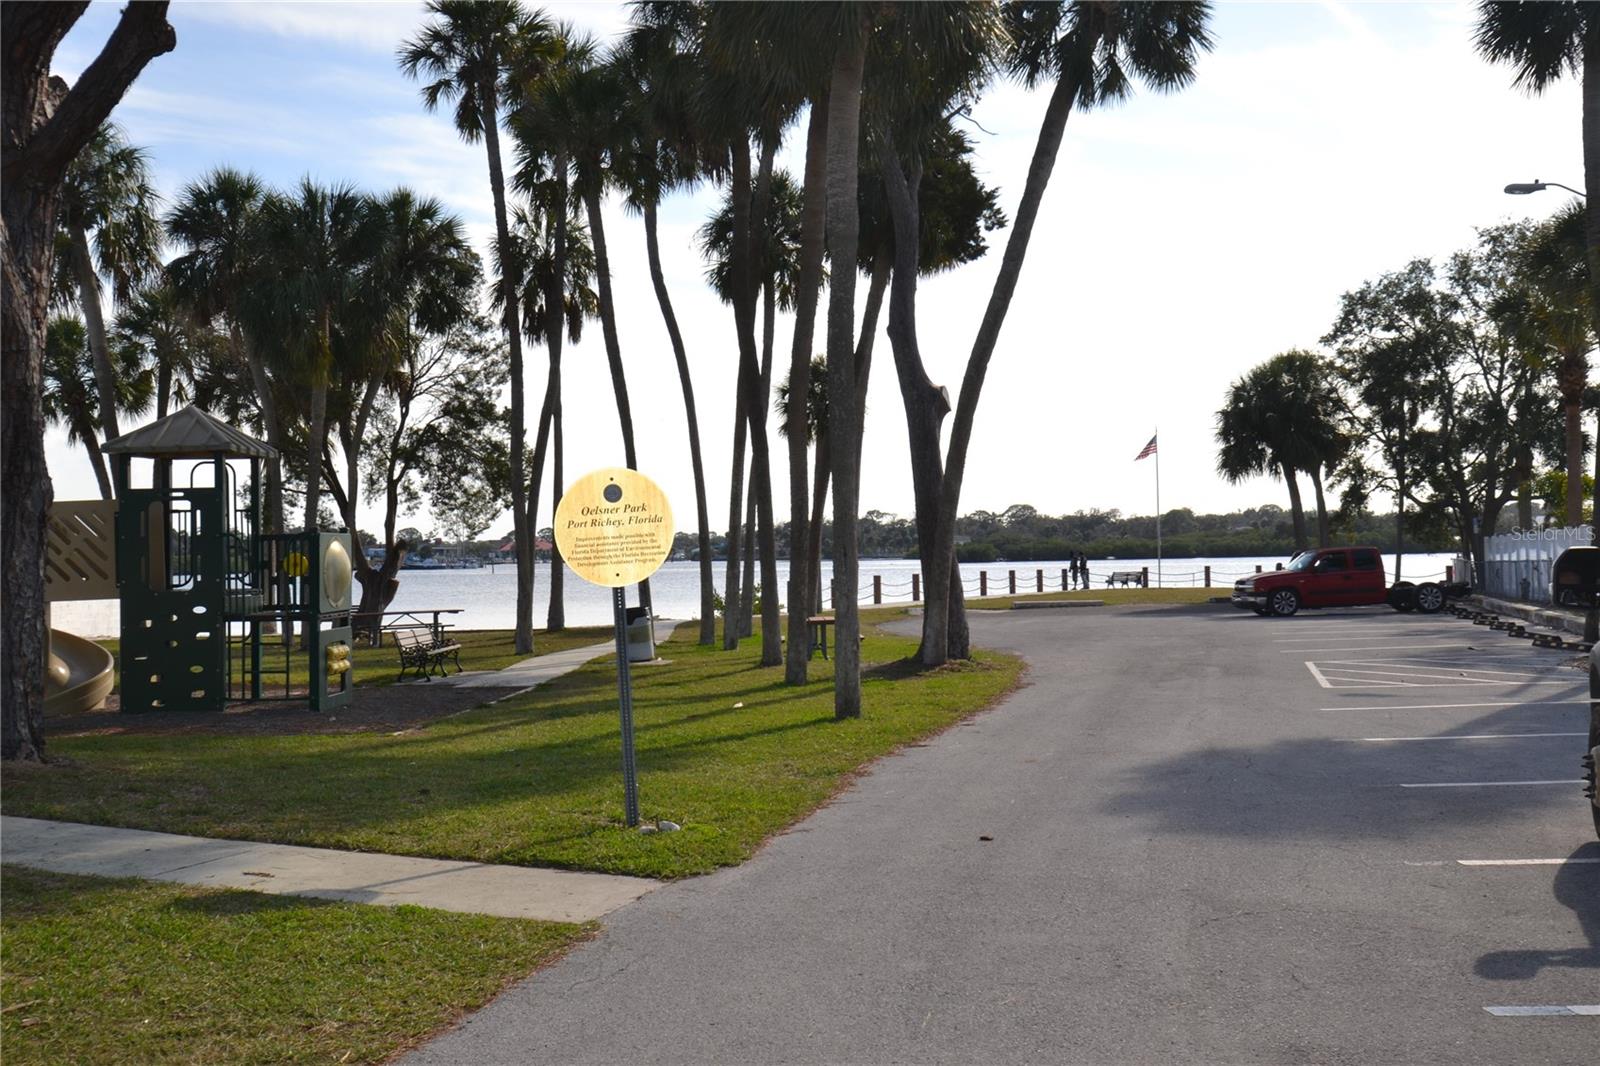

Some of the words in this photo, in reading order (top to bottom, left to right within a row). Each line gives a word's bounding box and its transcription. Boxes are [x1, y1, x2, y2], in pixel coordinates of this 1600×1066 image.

[581, 506, 620, 516] Oelsner
[624, 503, 647, 513] Park
[567, 520, 588, 528] Port
[628, 514, 663, 524] Florida
